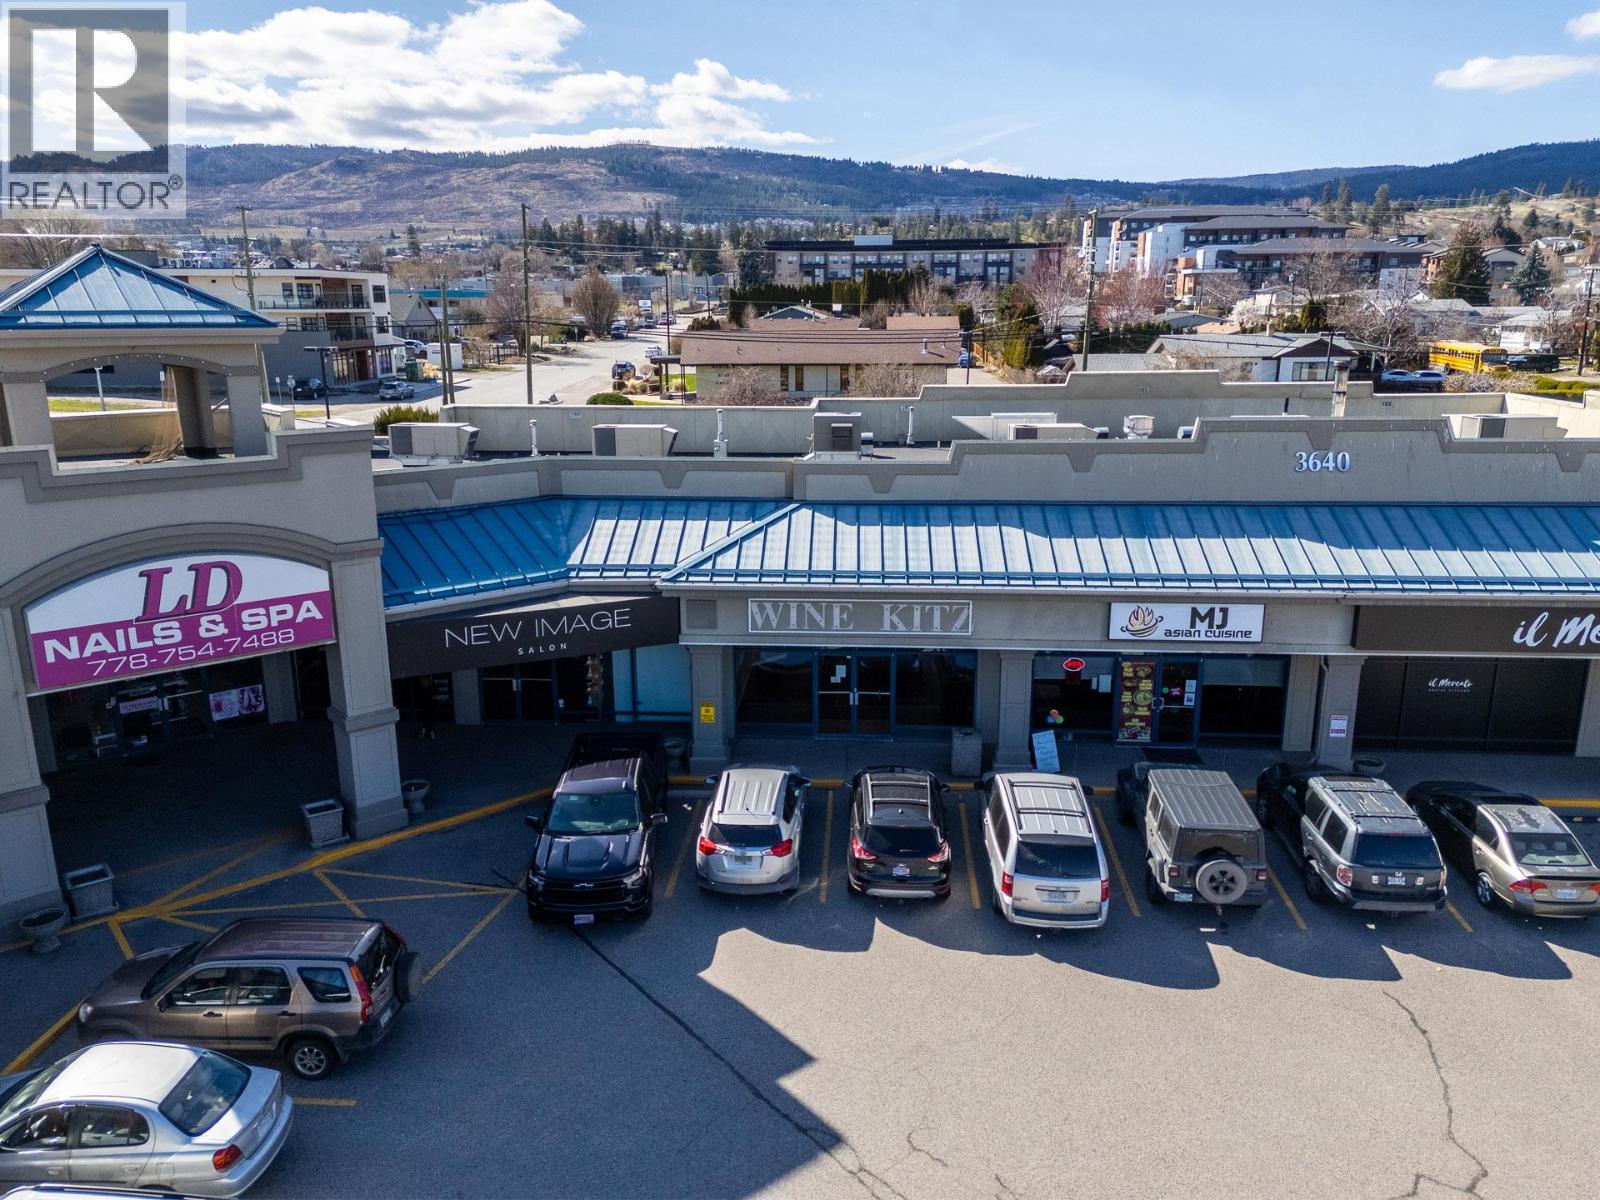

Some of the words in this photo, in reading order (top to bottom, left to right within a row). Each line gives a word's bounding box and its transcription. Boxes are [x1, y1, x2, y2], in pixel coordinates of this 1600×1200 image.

[1295, 451, 1350, 472] 3640
[134, 560, 243, 624] LD
[43, 620, 183, 663] NAILS
[198, 614, 229, 638] &
[241, 599, 323, 632] SPA
[444, 620, 523, 648] NEW
[534, 608, 632, 638] IMAGE
[750, 602, 854, 630] WINE
[879, 603, 972, 632] KITZ
[1189, 606, 1230, 630] MJ
[1513, 611, 1549, 647] il
[87, 628, 295, 677] 778-754-7488
[518, 642, 568, 656] SALON
